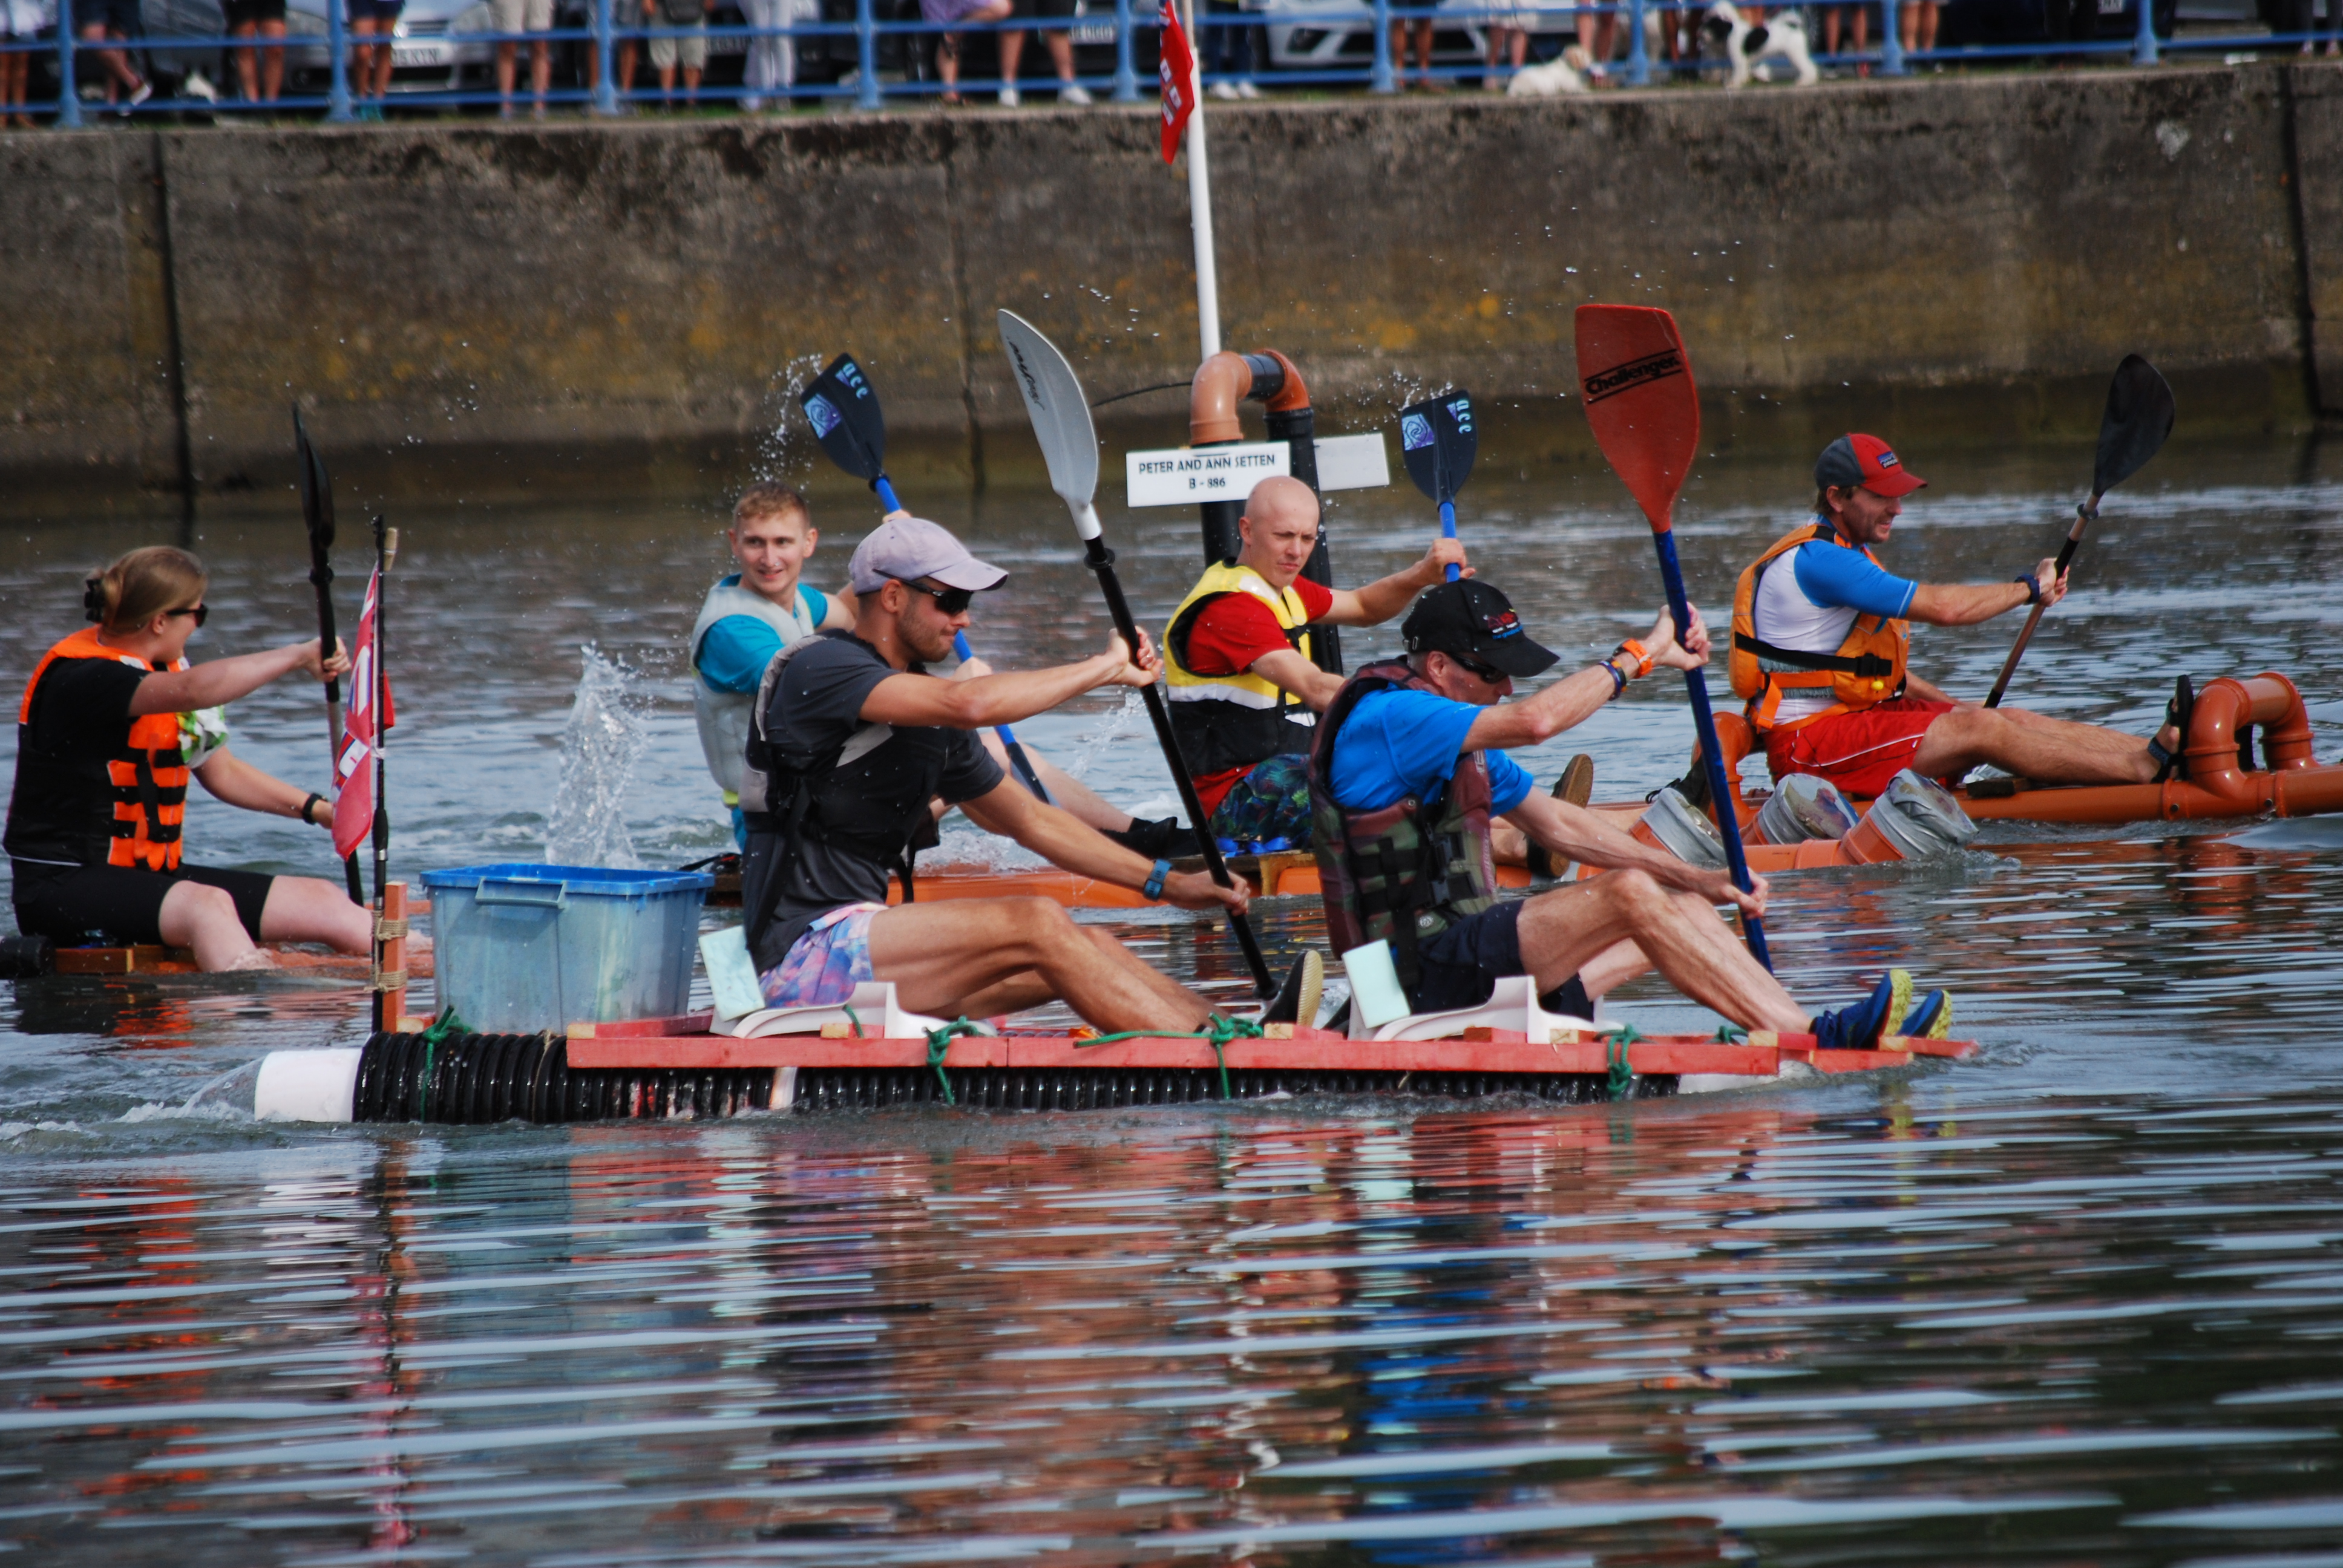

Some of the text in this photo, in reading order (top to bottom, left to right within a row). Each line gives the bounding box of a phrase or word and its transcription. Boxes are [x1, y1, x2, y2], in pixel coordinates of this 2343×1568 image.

[1139, 462, 1173, 474] PETER
[1177, 459, 1201, 471] AND
[1205, 457, 1231, 469] ANN
[1189, 478, 1196, 489] B
